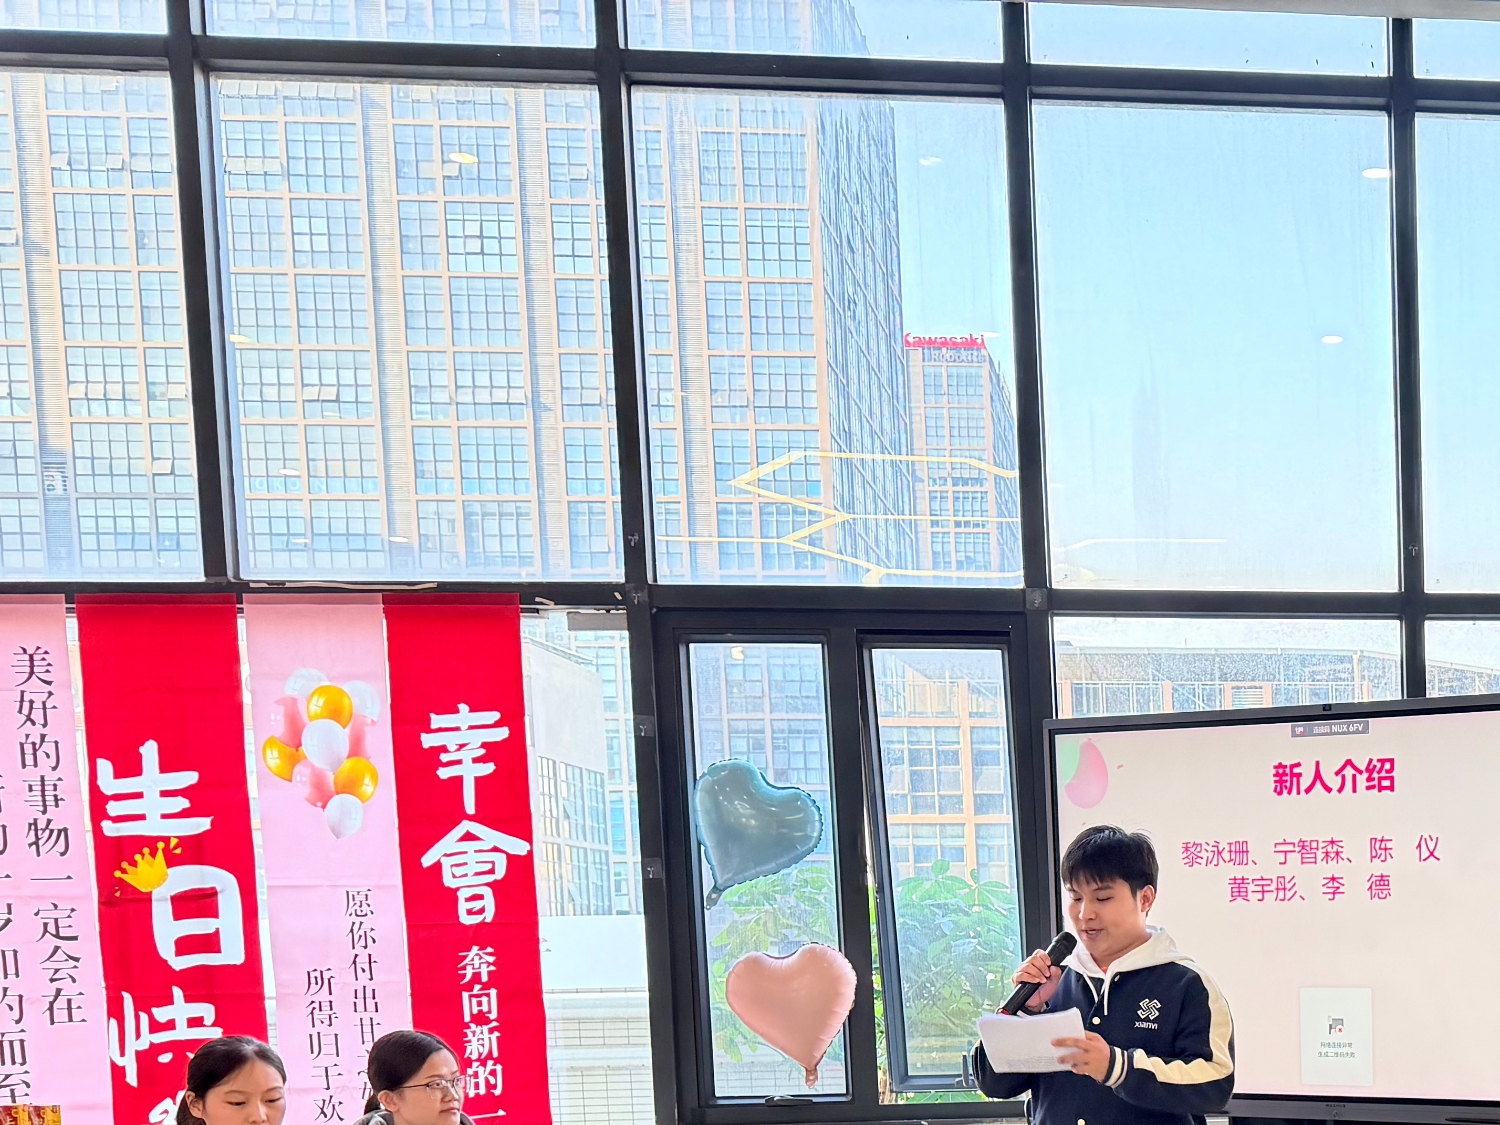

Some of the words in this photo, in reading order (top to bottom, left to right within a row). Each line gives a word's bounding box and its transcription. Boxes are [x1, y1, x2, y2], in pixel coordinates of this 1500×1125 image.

[903, 333, 984, 348] Kawasaki
[11, 645, 88, 1027] 美好的事物一定会在
[1272, 757, 1396, 796] 新人介绍
[97, 739, 245, 1125] 生日快
